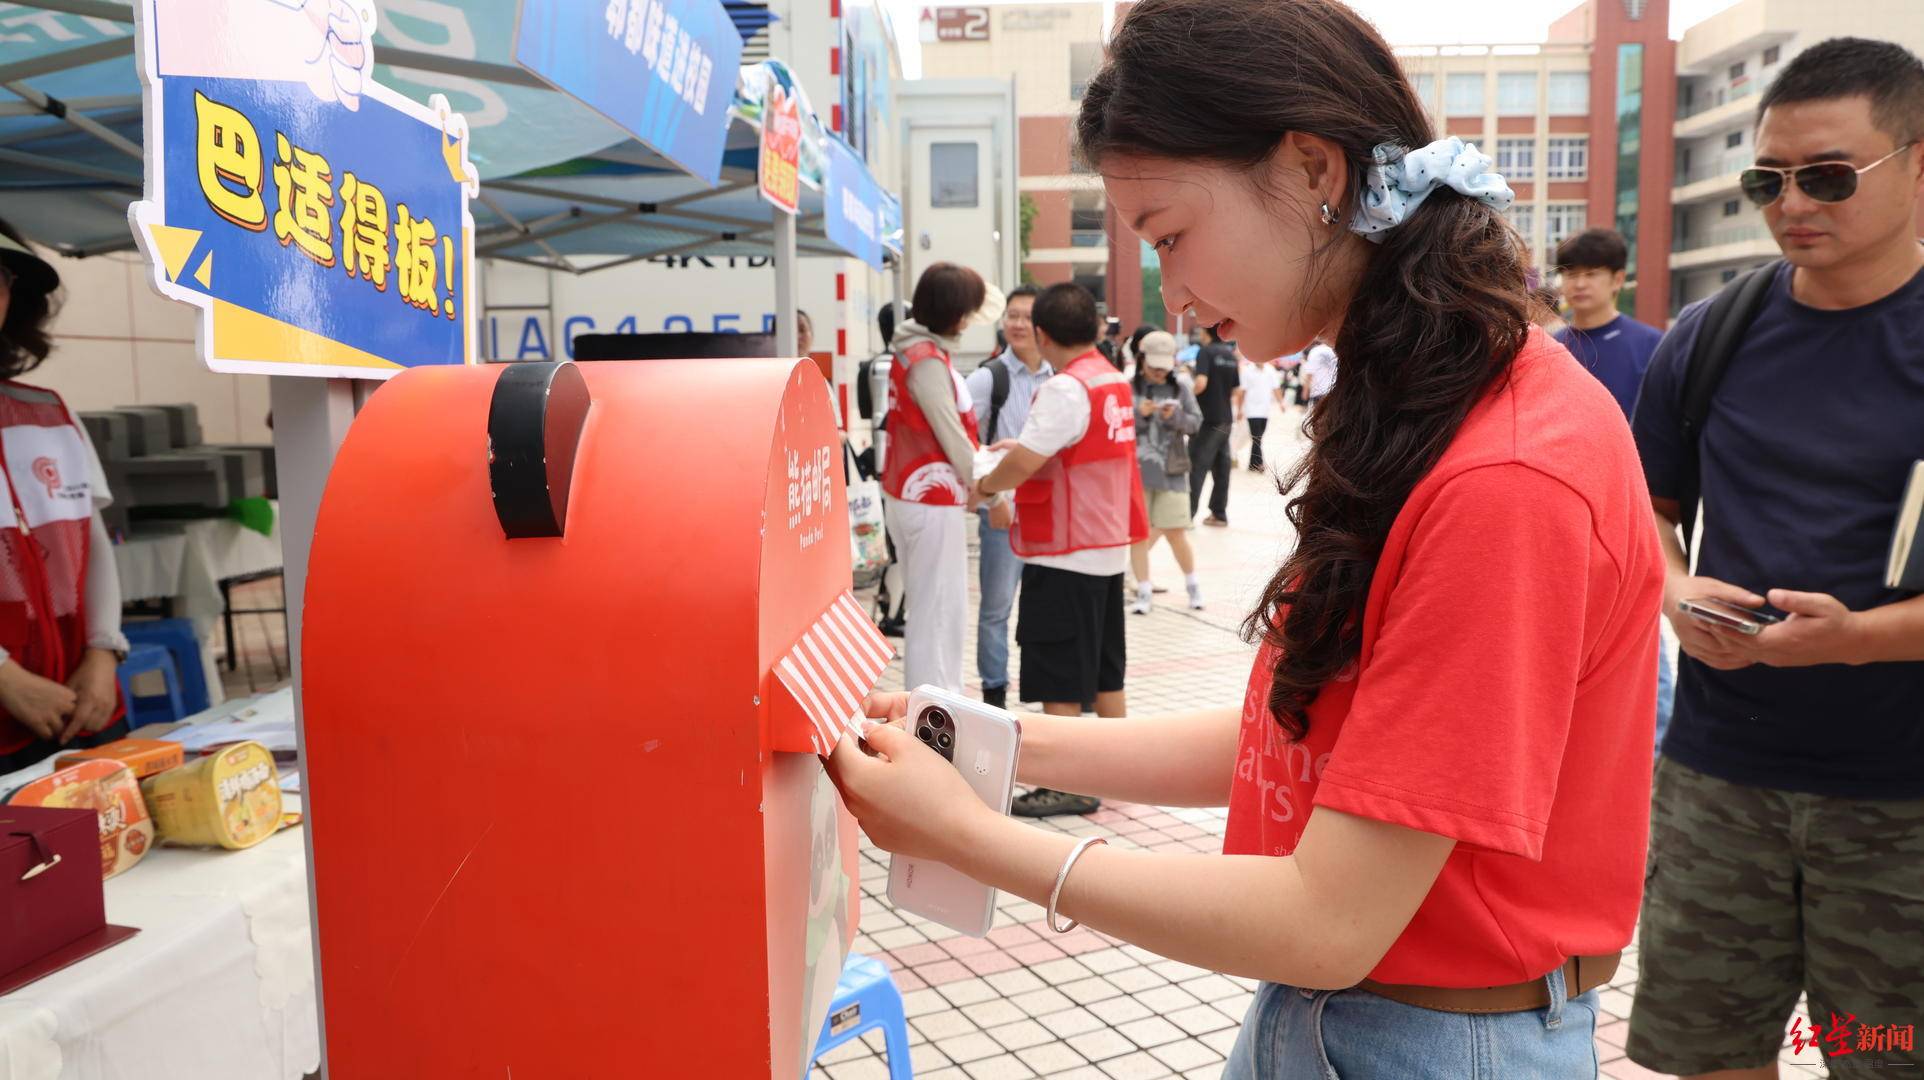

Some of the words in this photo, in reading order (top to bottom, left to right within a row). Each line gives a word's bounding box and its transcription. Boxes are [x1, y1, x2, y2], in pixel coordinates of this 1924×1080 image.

[964, 8, 988, 39] 2
[194, 88, 458, 321] 巴适得板!
[788, 446, 831, 530] 熊猫邮局
